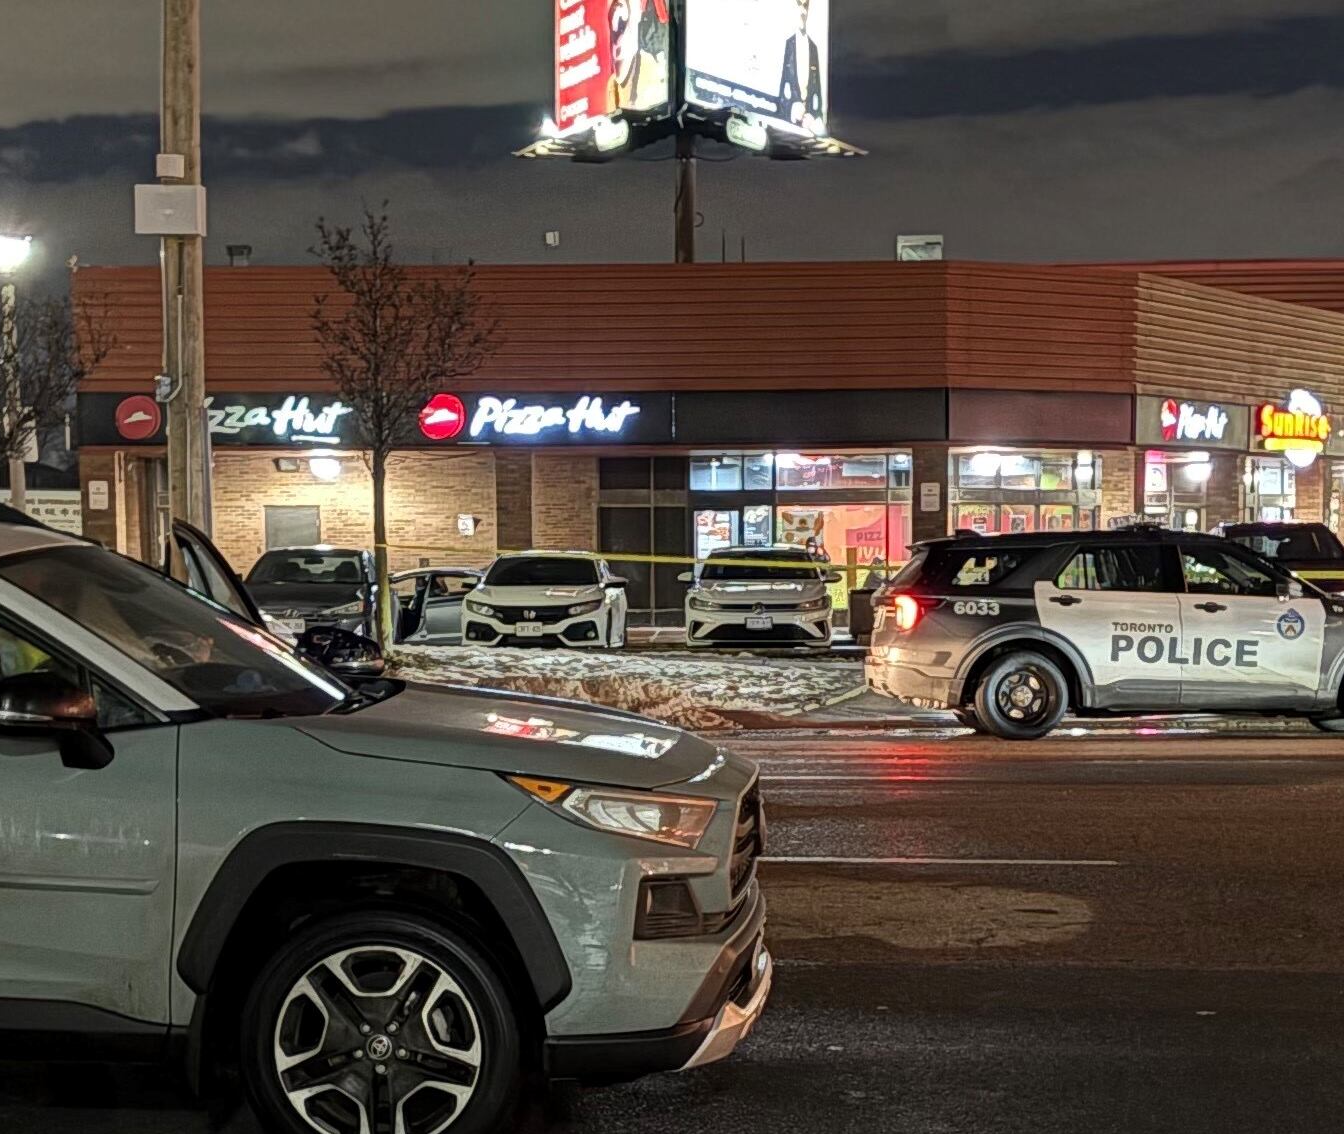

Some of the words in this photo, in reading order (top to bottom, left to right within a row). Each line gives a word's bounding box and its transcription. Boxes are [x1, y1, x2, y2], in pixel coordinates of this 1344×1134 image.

[272, 395, 353, 436] Hut
[470, 397, 566, 437] Pizza
[566, 396, 641, 433] Hut
[954, 600, 1000, 616] 6033
[1112, 622, 1174, 634] TORONTO
[1110, 634, 1259, 667] POLICE
